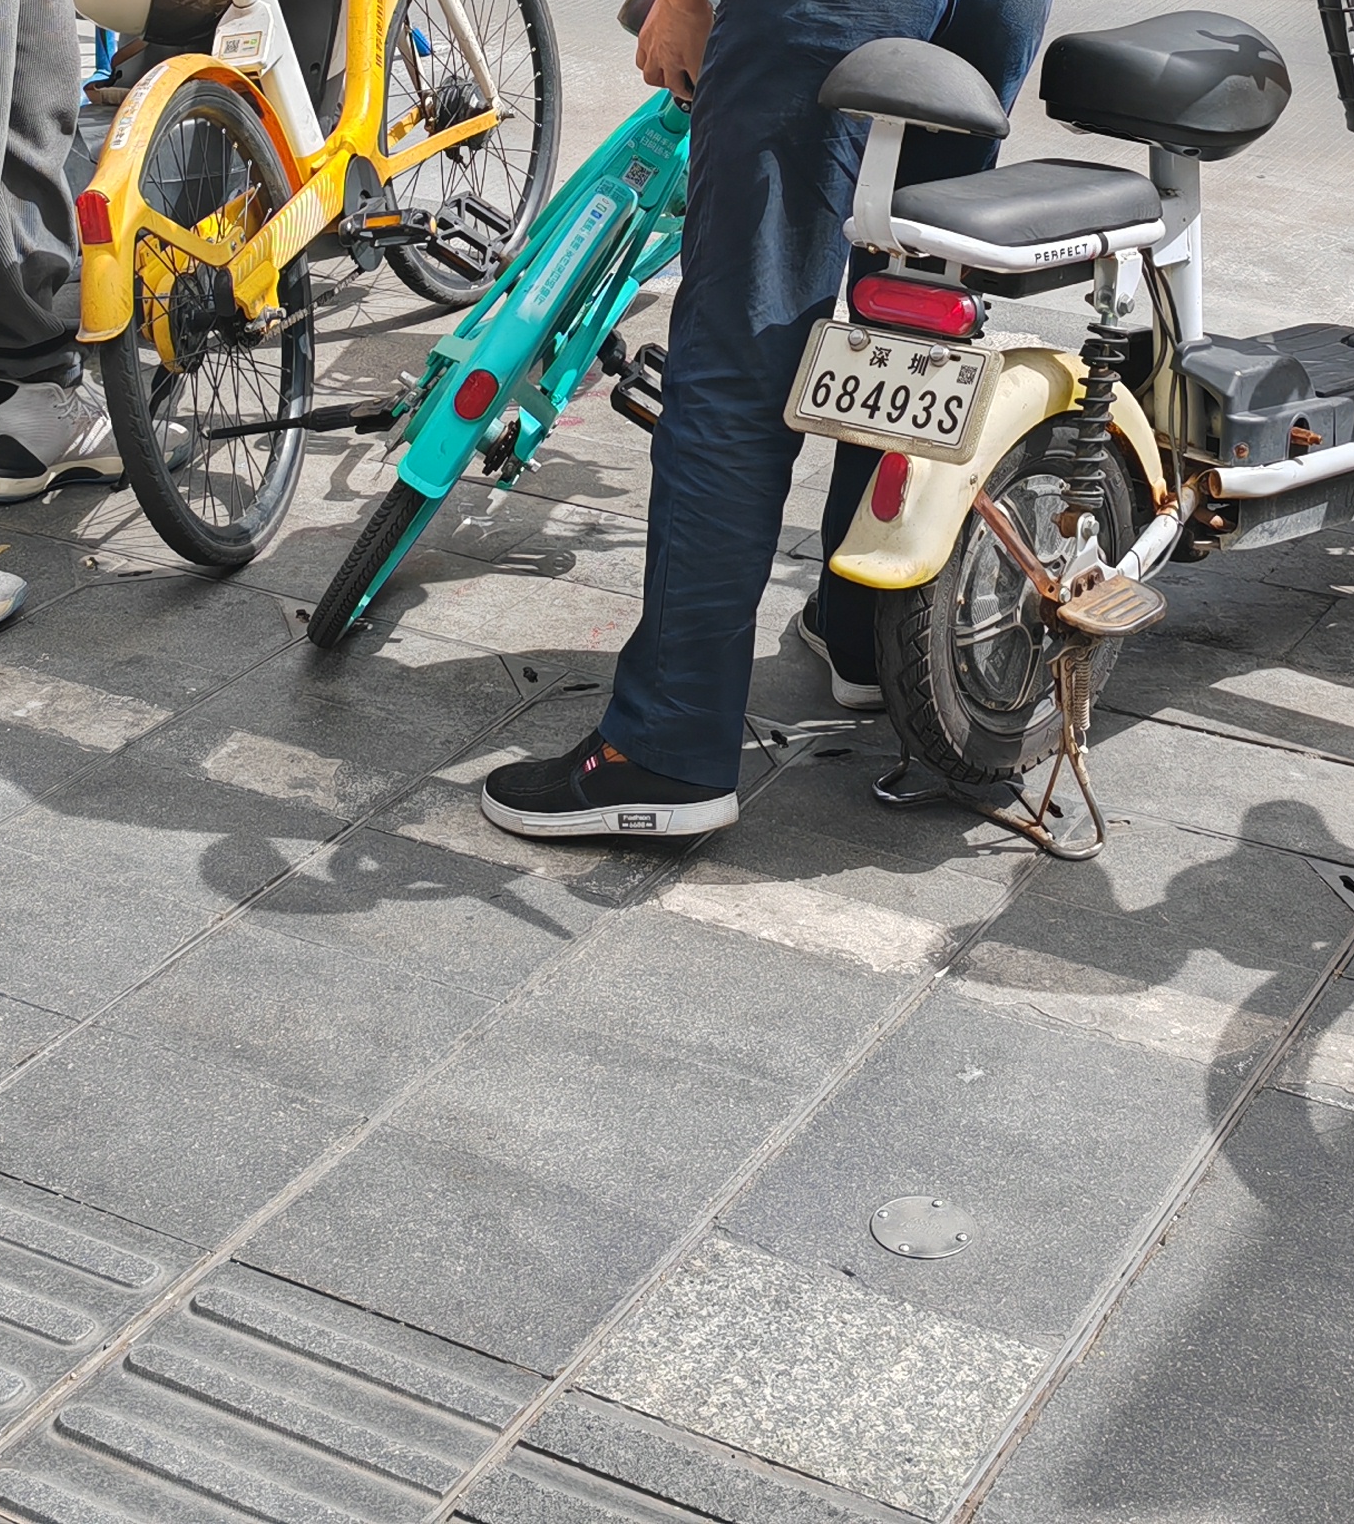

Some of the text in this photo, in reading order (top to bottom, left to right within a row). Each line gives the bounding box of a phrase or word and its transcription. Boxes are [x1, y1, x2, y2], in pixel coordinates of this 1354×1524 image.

[1034, 243, 1088, 264] PERFECT
[868, 346, 930, 376] 深圳
[811, 370, 963, 434] 68493S
